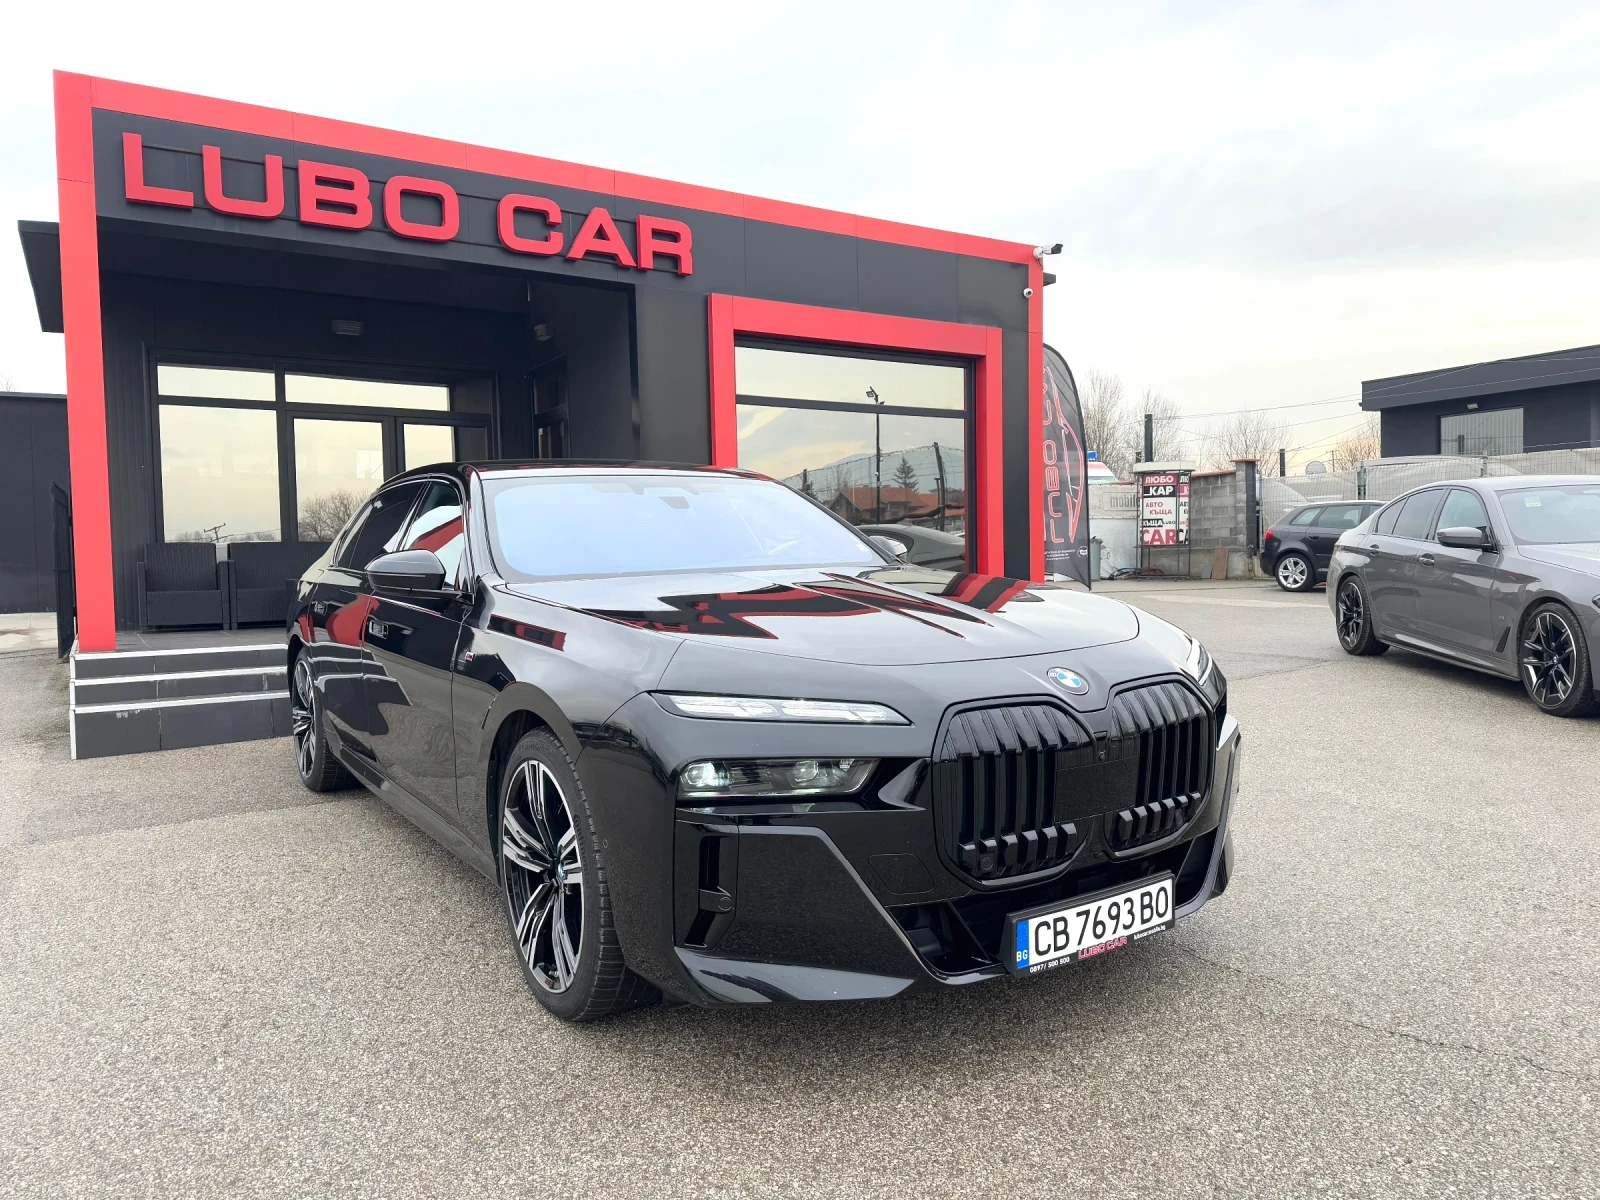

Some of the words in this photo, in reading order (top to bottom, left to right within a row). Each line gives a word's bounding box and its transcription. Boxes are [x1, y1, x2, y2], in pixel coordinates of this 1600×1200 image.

[122, 132, 460, 242] LUBO
[496, 193, 693, 276] CAR
[1145, 475, 1174, 484] ЛЮБО
[1149, 485, 1174, 495] КАР
[1143, 528, 1176, 545] CAR
[1034, 916, 1070, 956] CB
[1076, 897, 1136, 946] 7693
[1140, 886, 1169, 925] BO
[1016, 949, 1028, 962] BG
[1078, 943, 1106, 960] LUBO
[1106, 936, 1128, 950] CAR
